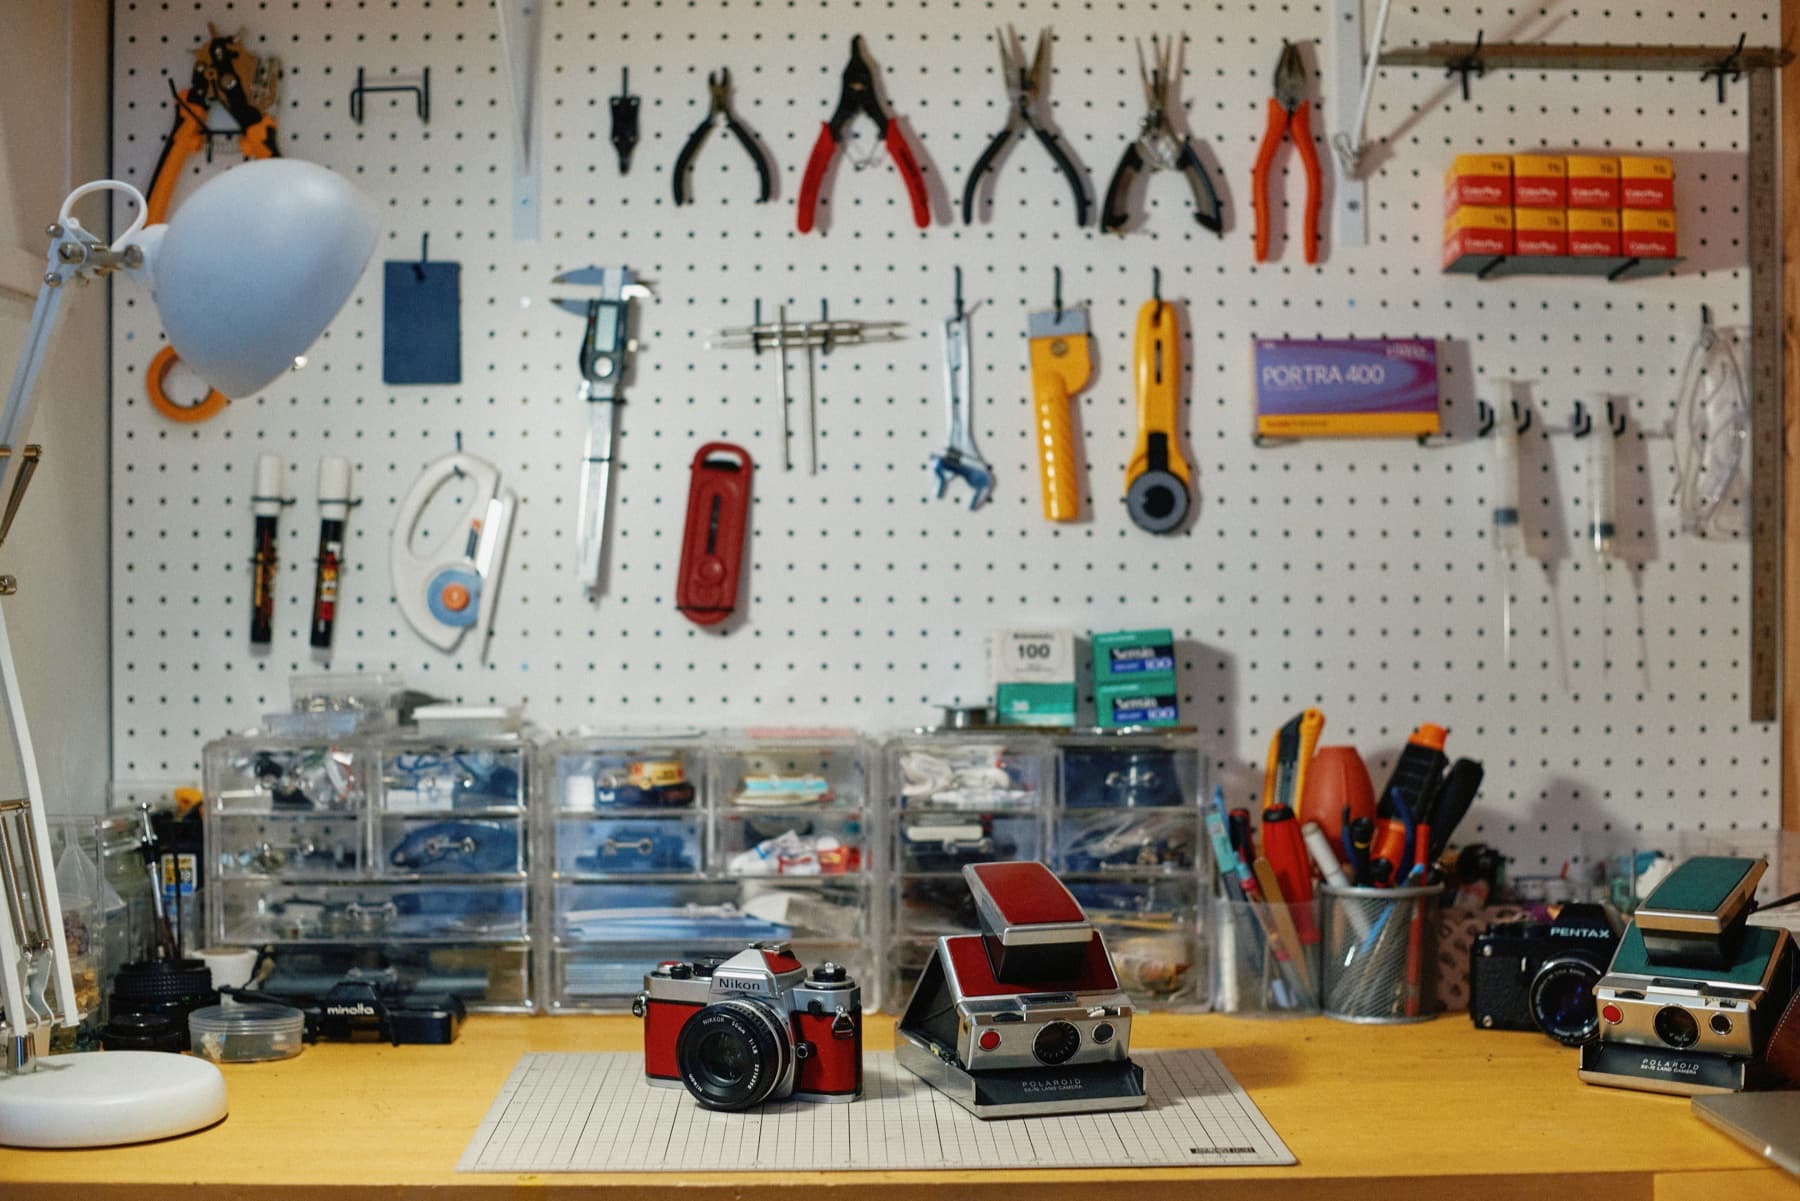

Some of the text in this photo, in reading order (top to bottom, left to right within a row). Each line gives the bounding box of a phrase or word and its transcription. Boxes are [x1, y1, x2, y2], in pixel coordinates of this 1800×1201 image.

[1262, 364, 1385, 386] PORTRA 400
[1017, 643, 1050, 660] 100
[1145, 656, 1173, 670] 100
[1147, 705, 1176, 719] 100
[1550, 926, 1610, 938] PENTAX
[719, 978, 760, 991] Nikon
[327, 1002, 375, 1015] minolta
[1641, 1058, 1700, 1070] POLAROID
[1022, 1079, 1081, 1088] POLAROID
